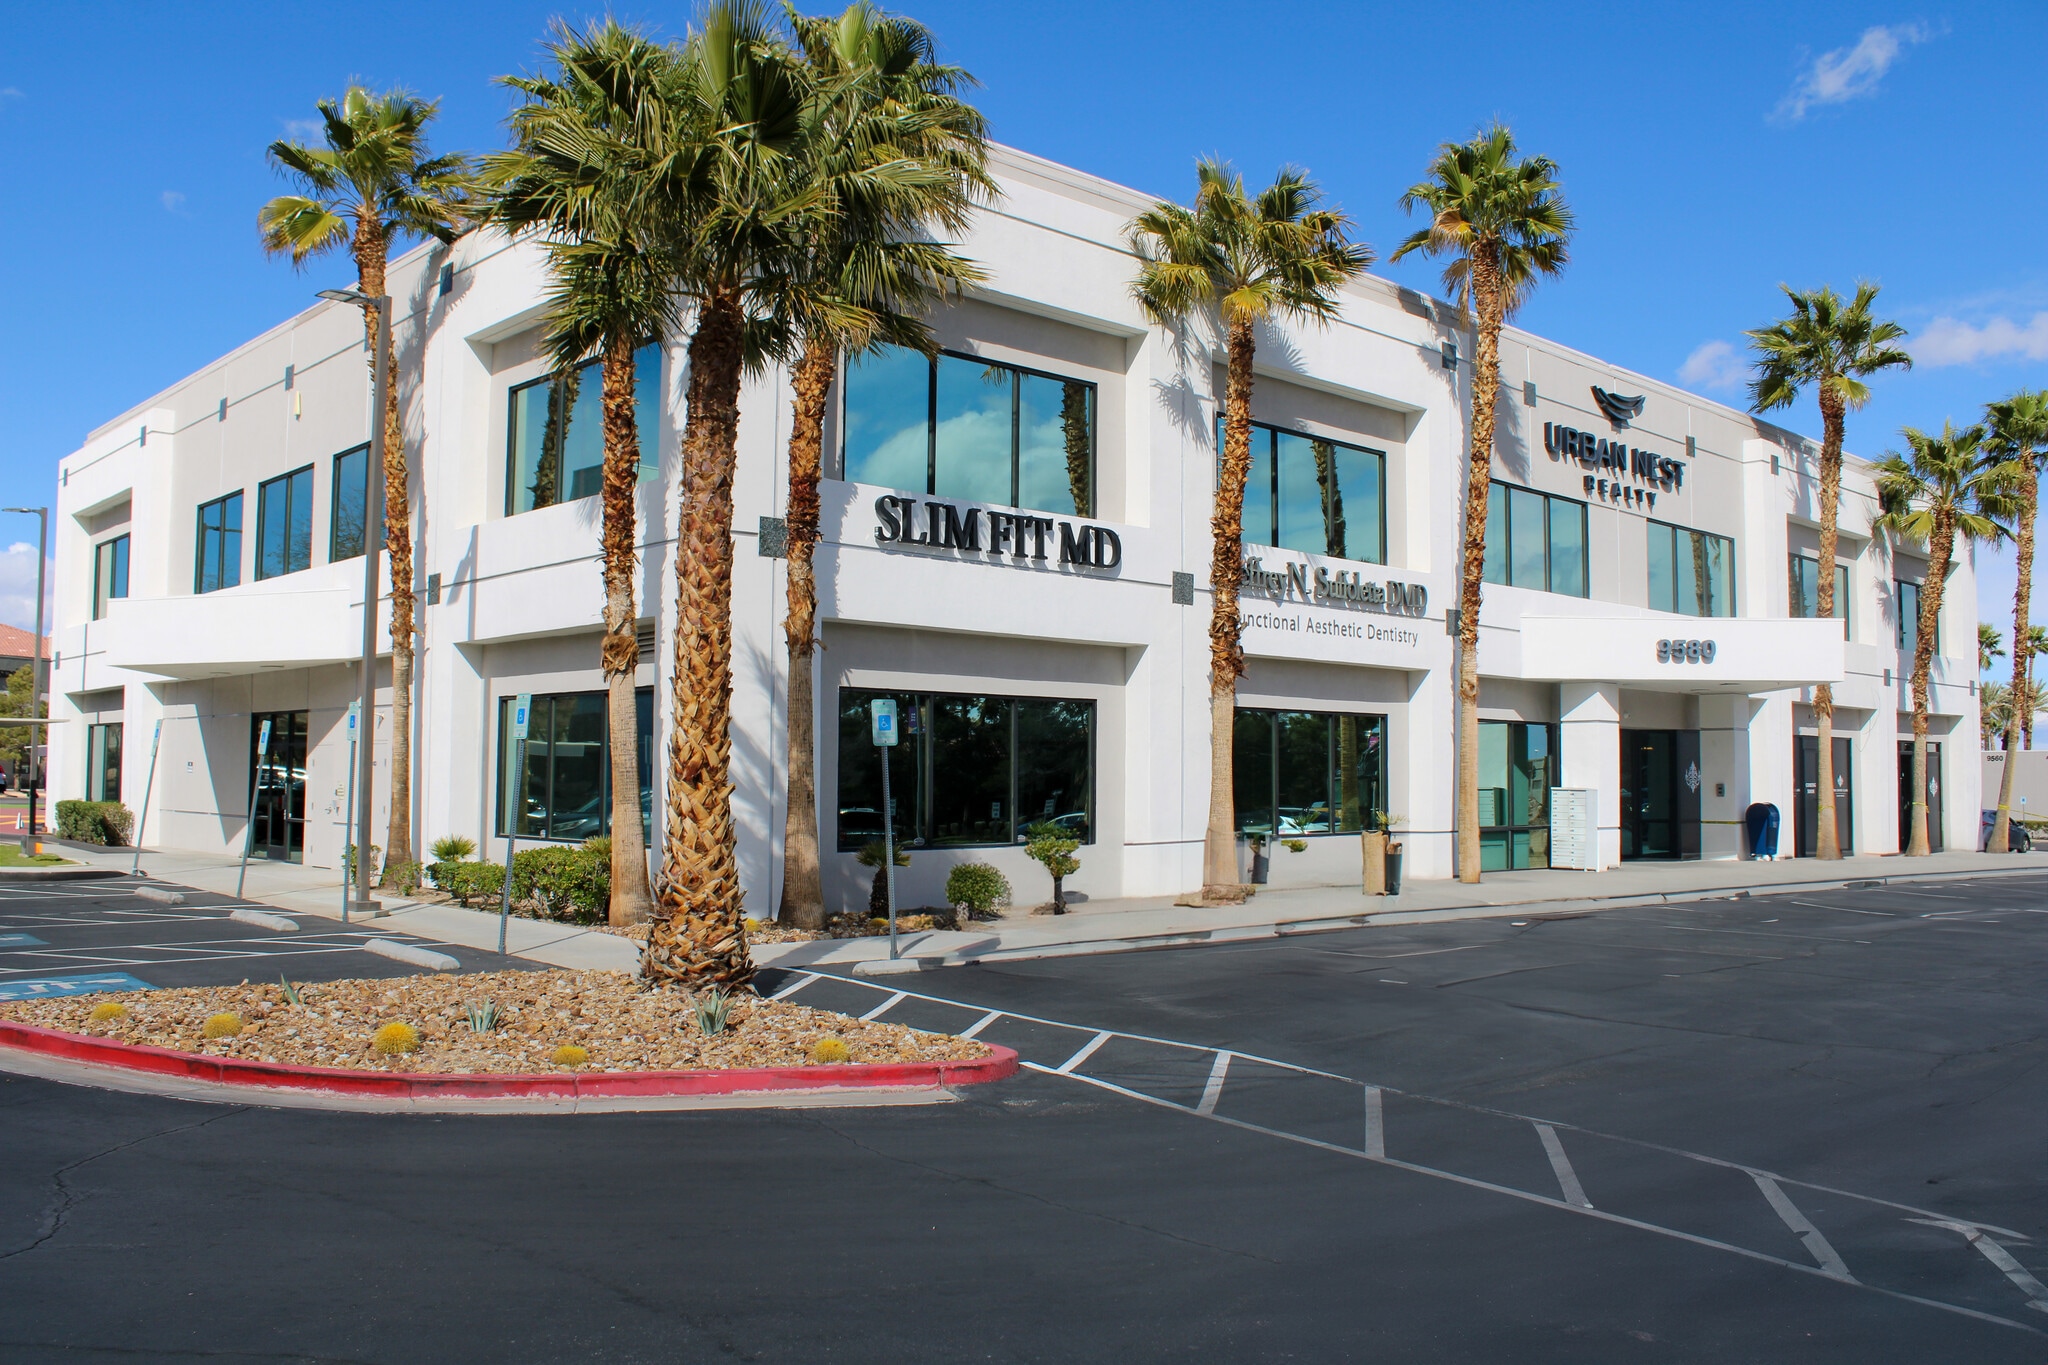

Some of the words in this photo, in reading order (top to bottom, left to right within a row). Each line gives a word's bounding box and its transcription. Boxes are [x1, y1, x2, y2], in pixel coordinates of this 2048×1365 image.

[1544, 421, 1626, 473] URBAN
[1631, 447, 1686, 488] NEST
[1583, 475, 1656, 506] REALTY
[874, 495, 981, 552] SLIM
[986, 510, 1053, 560] FIT
[1057, 521, 1122, 568] MD
[1240, 556, 1287, 597] effrey
[1386, 580, 1428, 608] DMD
[1240, 612, 1300, 632] unctional
[1306, 617, 1362, 638] Aesthetic
[1367, 624, 1419, 647] Dentistry
[1656, 639, 1716, 658] 9580
